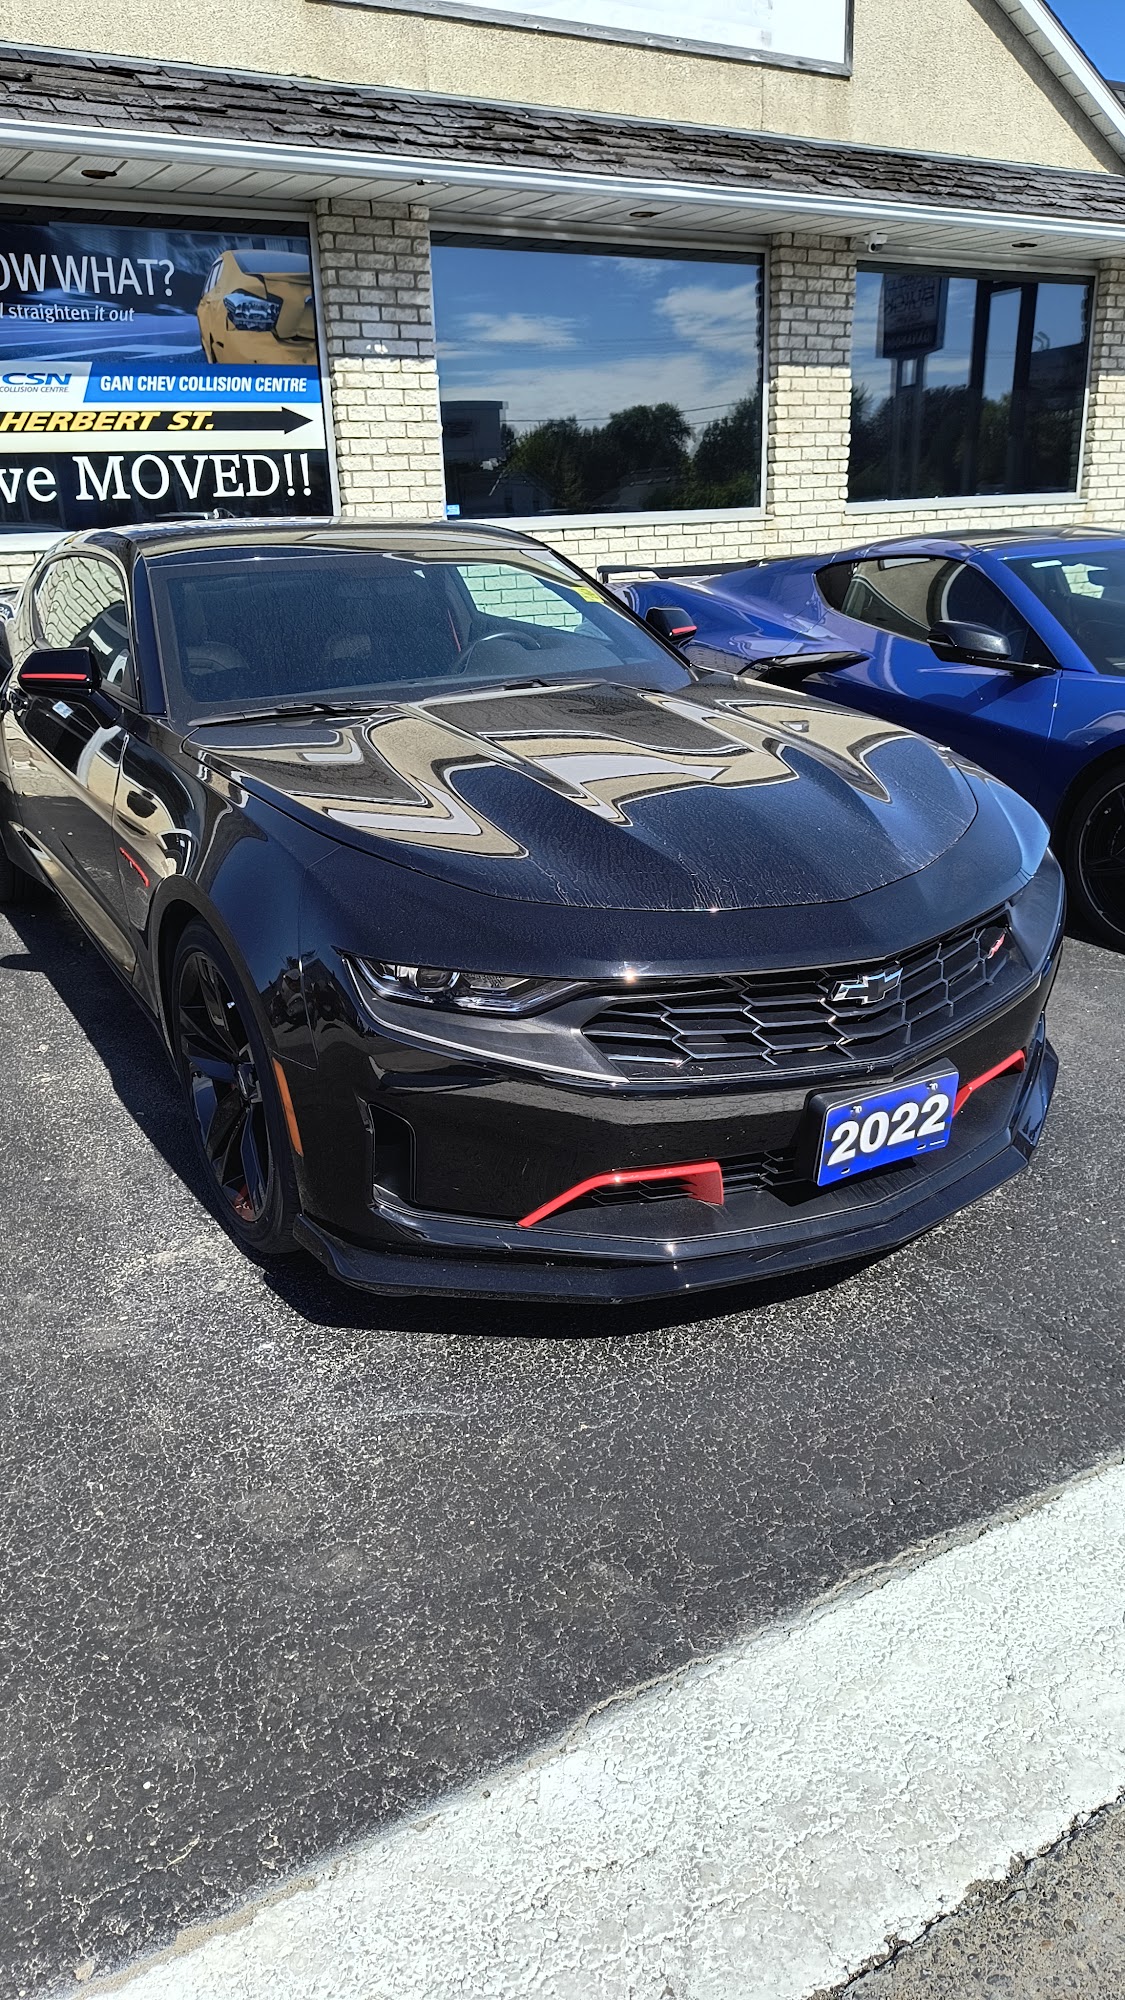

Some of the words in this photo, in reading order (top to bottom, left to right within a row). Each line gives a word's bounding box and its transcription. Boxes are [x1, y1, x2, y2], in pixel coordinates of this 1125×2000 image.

[51, 254, 175, 297] WHAT?
[8, 303, 90, 324] straighten
[94, 305, 105, 321] it
[109, 307, 135, 322] out
[2, 372, 72, 386] CSN
[100, 375, 134, 392] GAN
[137, 376, 176, 392] CHEV
[178, 376, 252, 393] COLLISION
[254, 377, 307, 393] CENTRE
[0, 411, 161, 432] HERBERT
[167, 411, 214, 431] ST.
[72, 452, 312, 502] MOVED!!
[827, 1093, 950, 1167] 2022
